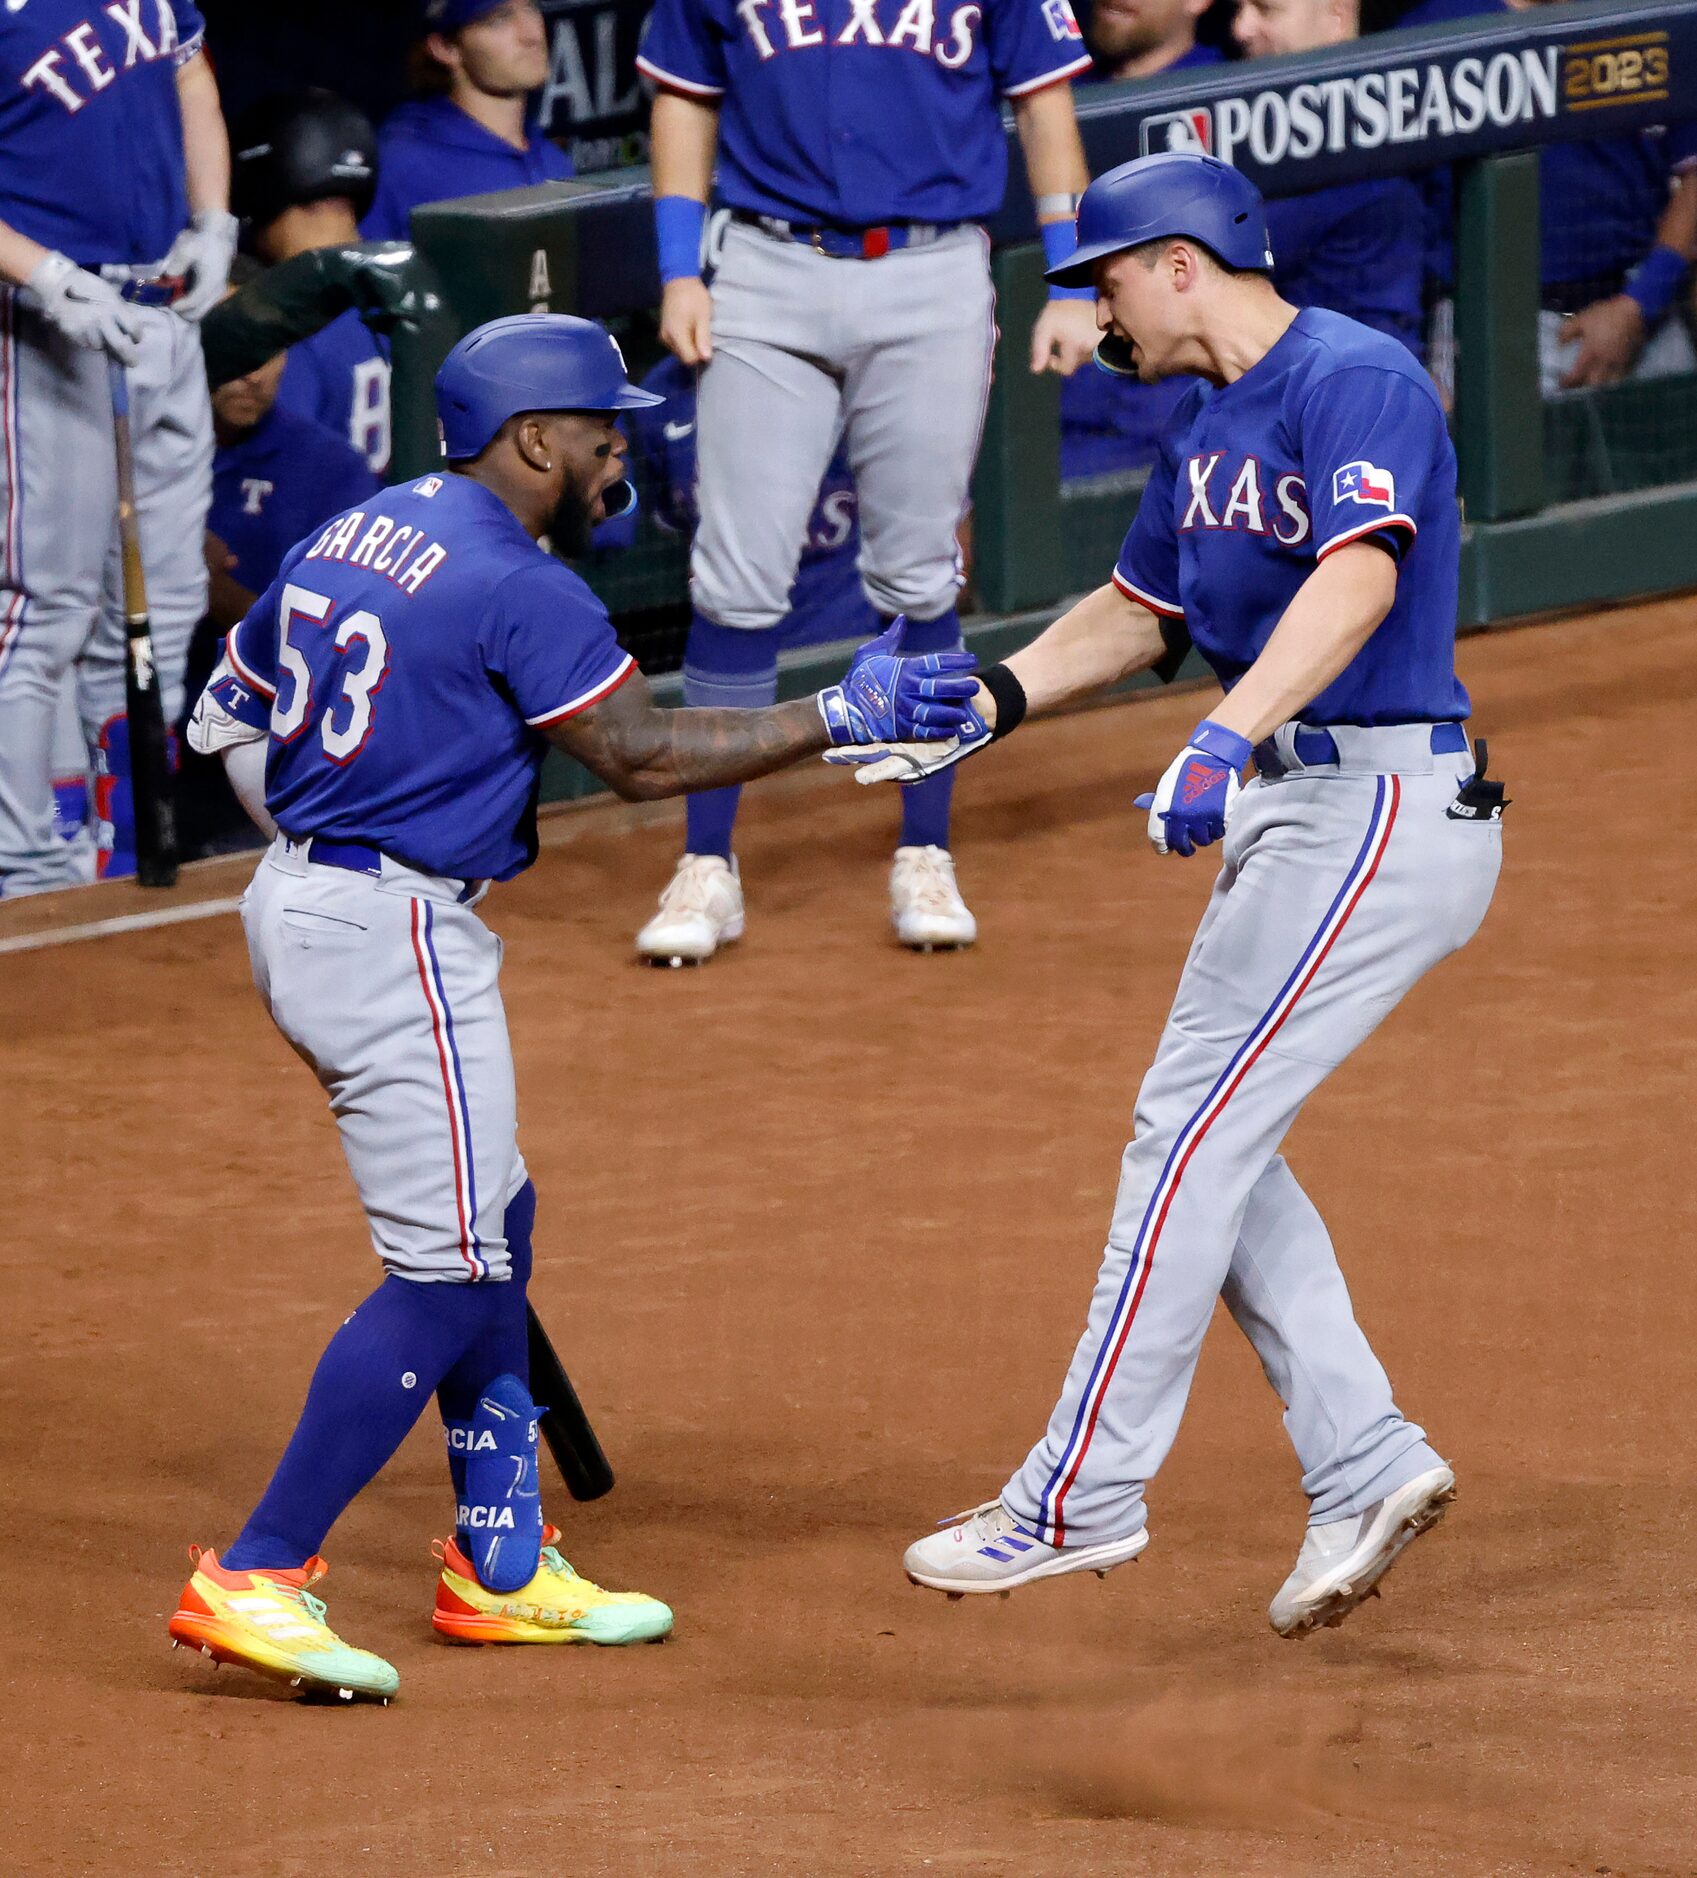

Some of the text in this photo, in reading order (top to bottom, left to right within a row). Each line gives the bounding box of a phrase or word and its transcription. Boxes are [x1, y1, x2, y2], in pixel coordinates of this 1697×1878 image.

[538, 12, 654, 128] AL
[1215, 45, 1670, 165] POSTSEASON 2023
[241, 477, 274, 516] T
[1180, 453, 1311, 547] XAS
[304, 511, 449, 597] GARCIA
[270, 583, 391, 766] 53
[1183, 770, 1227, 805] adidas
